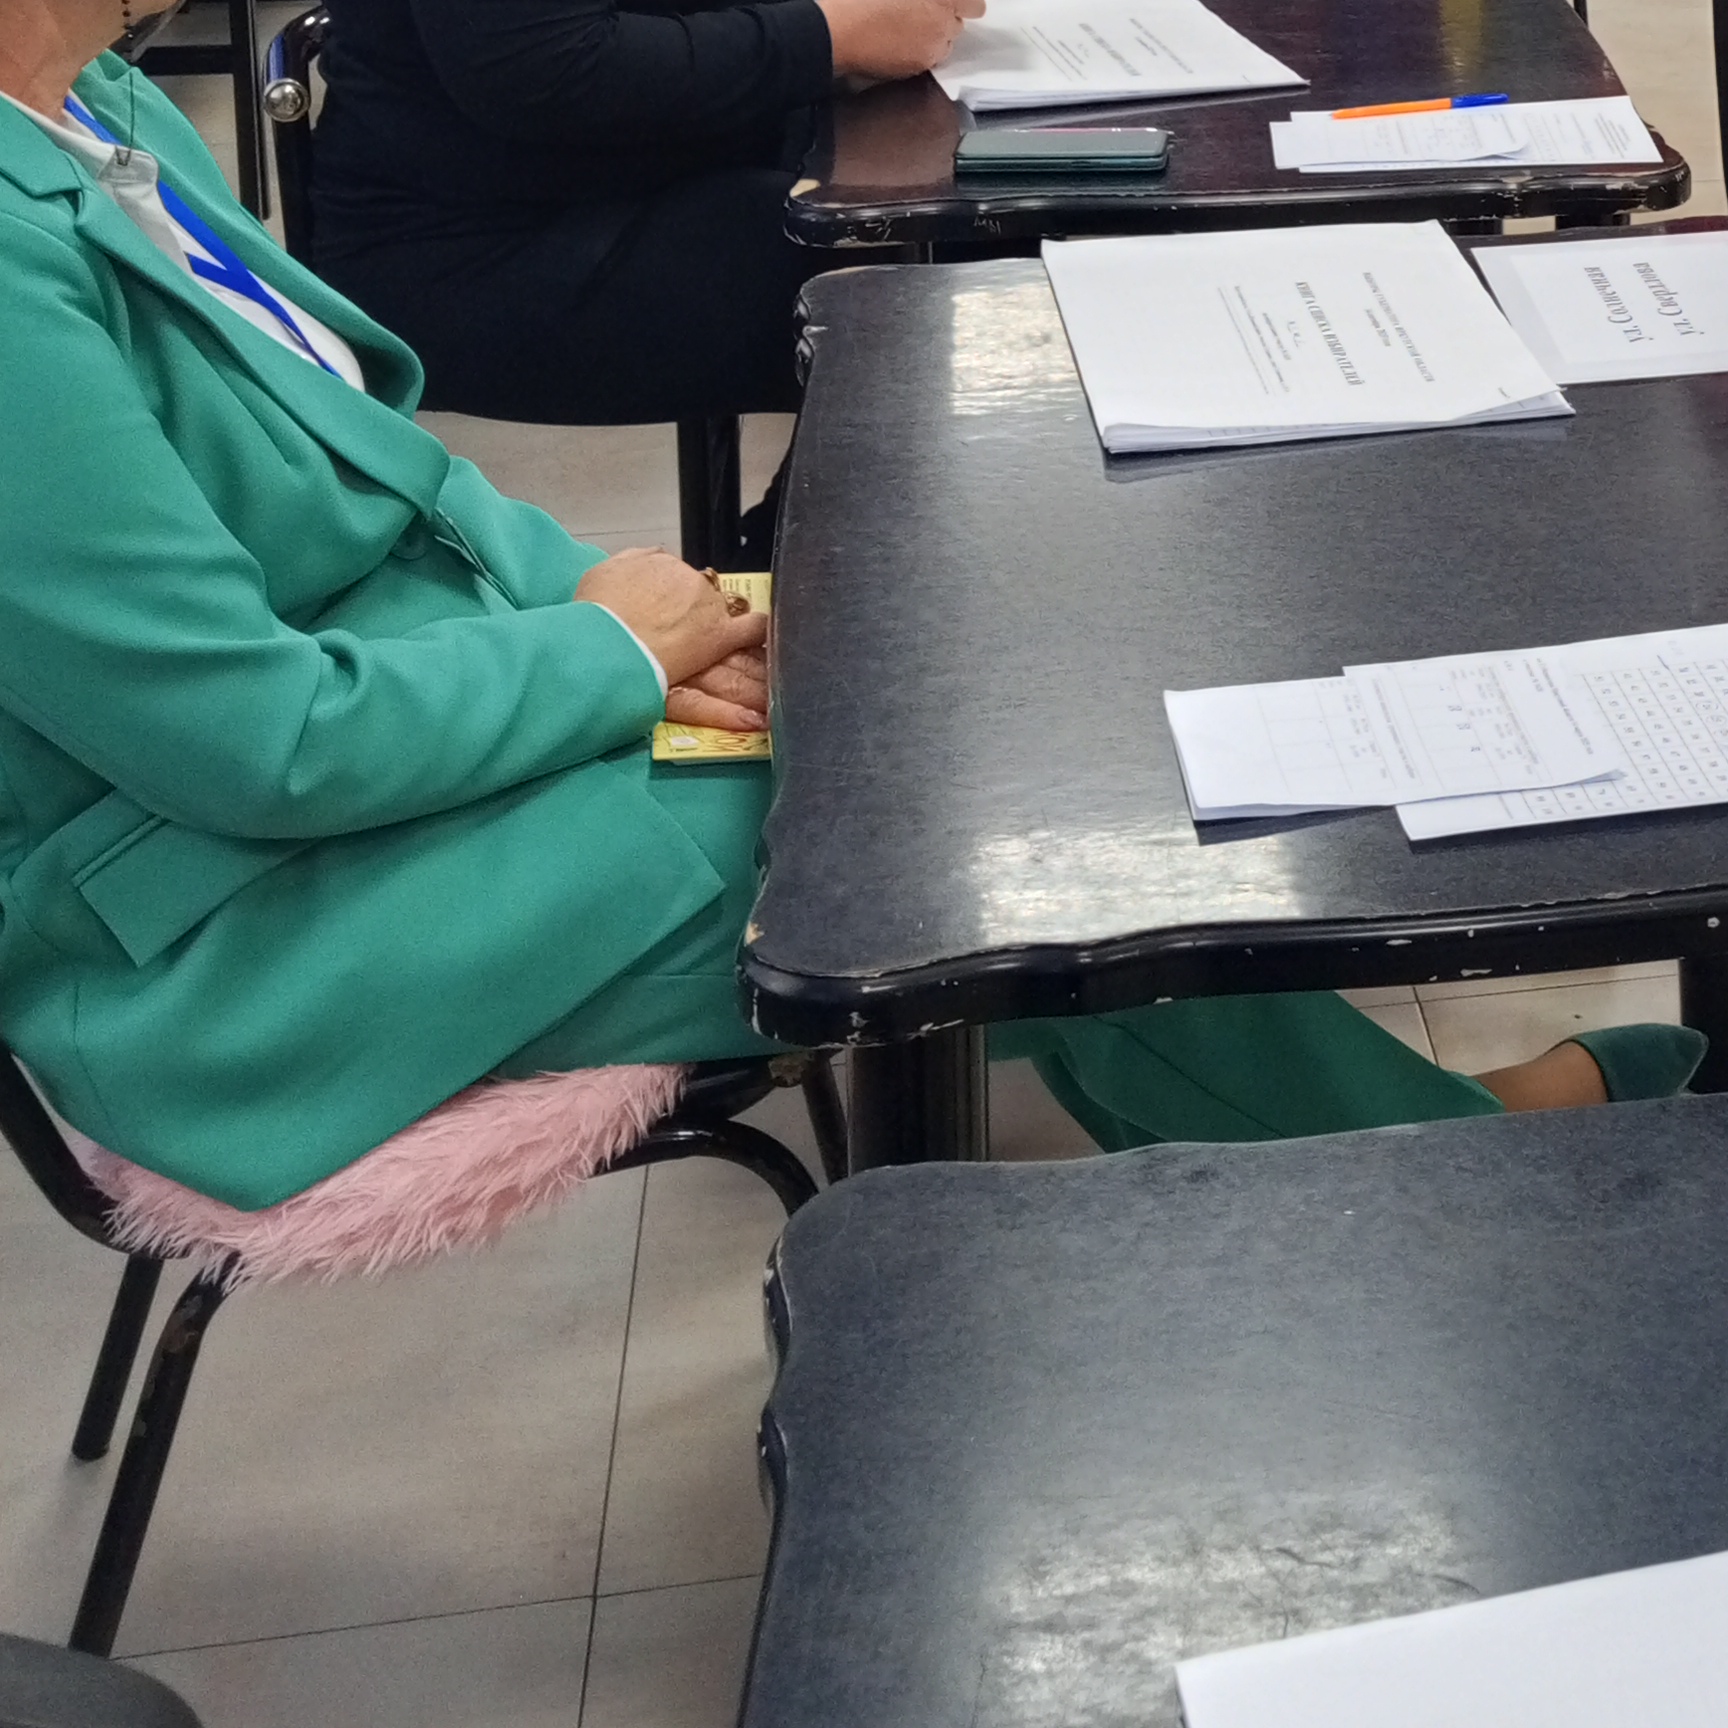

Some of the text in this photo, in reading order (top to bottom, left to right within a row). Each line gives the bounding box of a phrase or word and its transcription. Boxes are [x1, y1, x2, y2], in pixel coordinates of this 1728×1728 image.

[1583, 265, 1655, 343] ул. Солнечная
[1632, 262, 1706, 336] ул. Свердлова
